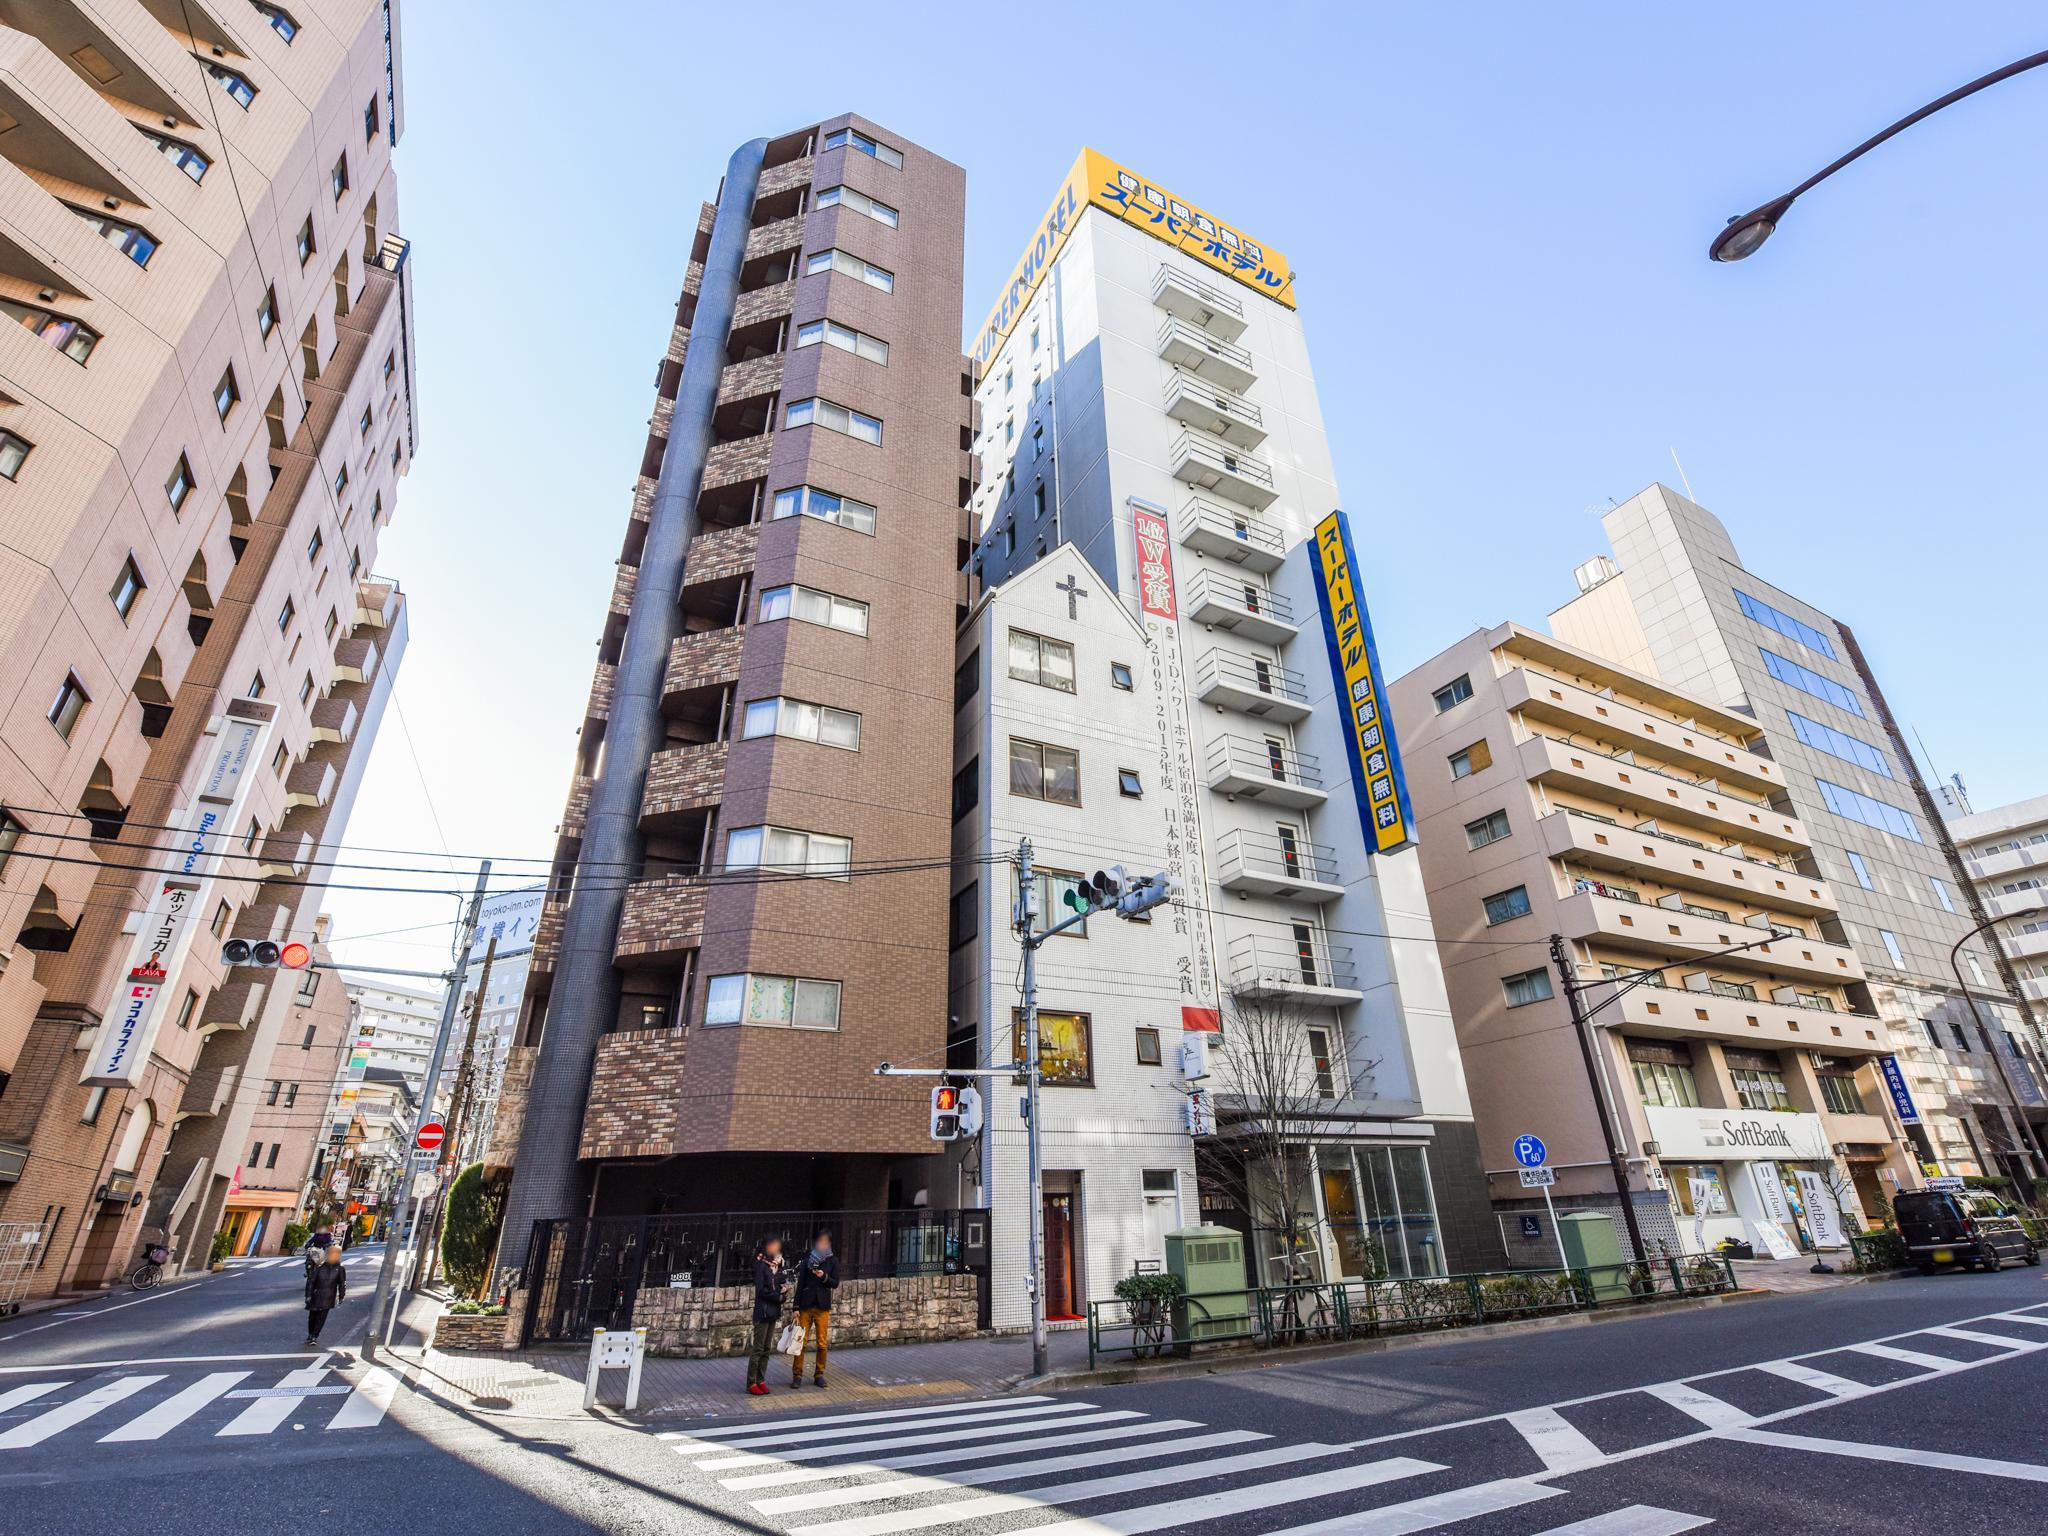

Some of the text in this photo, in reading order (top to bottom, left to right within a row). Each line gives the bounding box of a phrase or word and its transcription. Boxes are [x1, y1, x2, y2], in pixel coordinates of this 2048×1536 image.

[1022, 183, 1077, 294] HOTEL
[1101, 182, 1283, 288] スーパーホテル
[1117, 170, 1264, 263] 健康朝食無料
[1324, 526, 1362, 674] スーパーホテル
[234, 728, 254, 765] PLANNING
[1351, 676, 1396, 829] 健康朝食無料
[210, 750, 232, 793] PROMOTION
[150, 891, 187, 952] ホットヨガ
[138, 968, 161, 978] LAVA
[1177, 956, 1193, 995] 受賞
[107, 1000, 143, 1074] ココカラファイン
[1519, 1143, 1540, 1163] P 60
[1722, 1119, 1791, 1147] SoftBank
[1764, 1179, 1783, 1219] SoftBank
[1807, 1192, 1830, 1240] SoftBank
